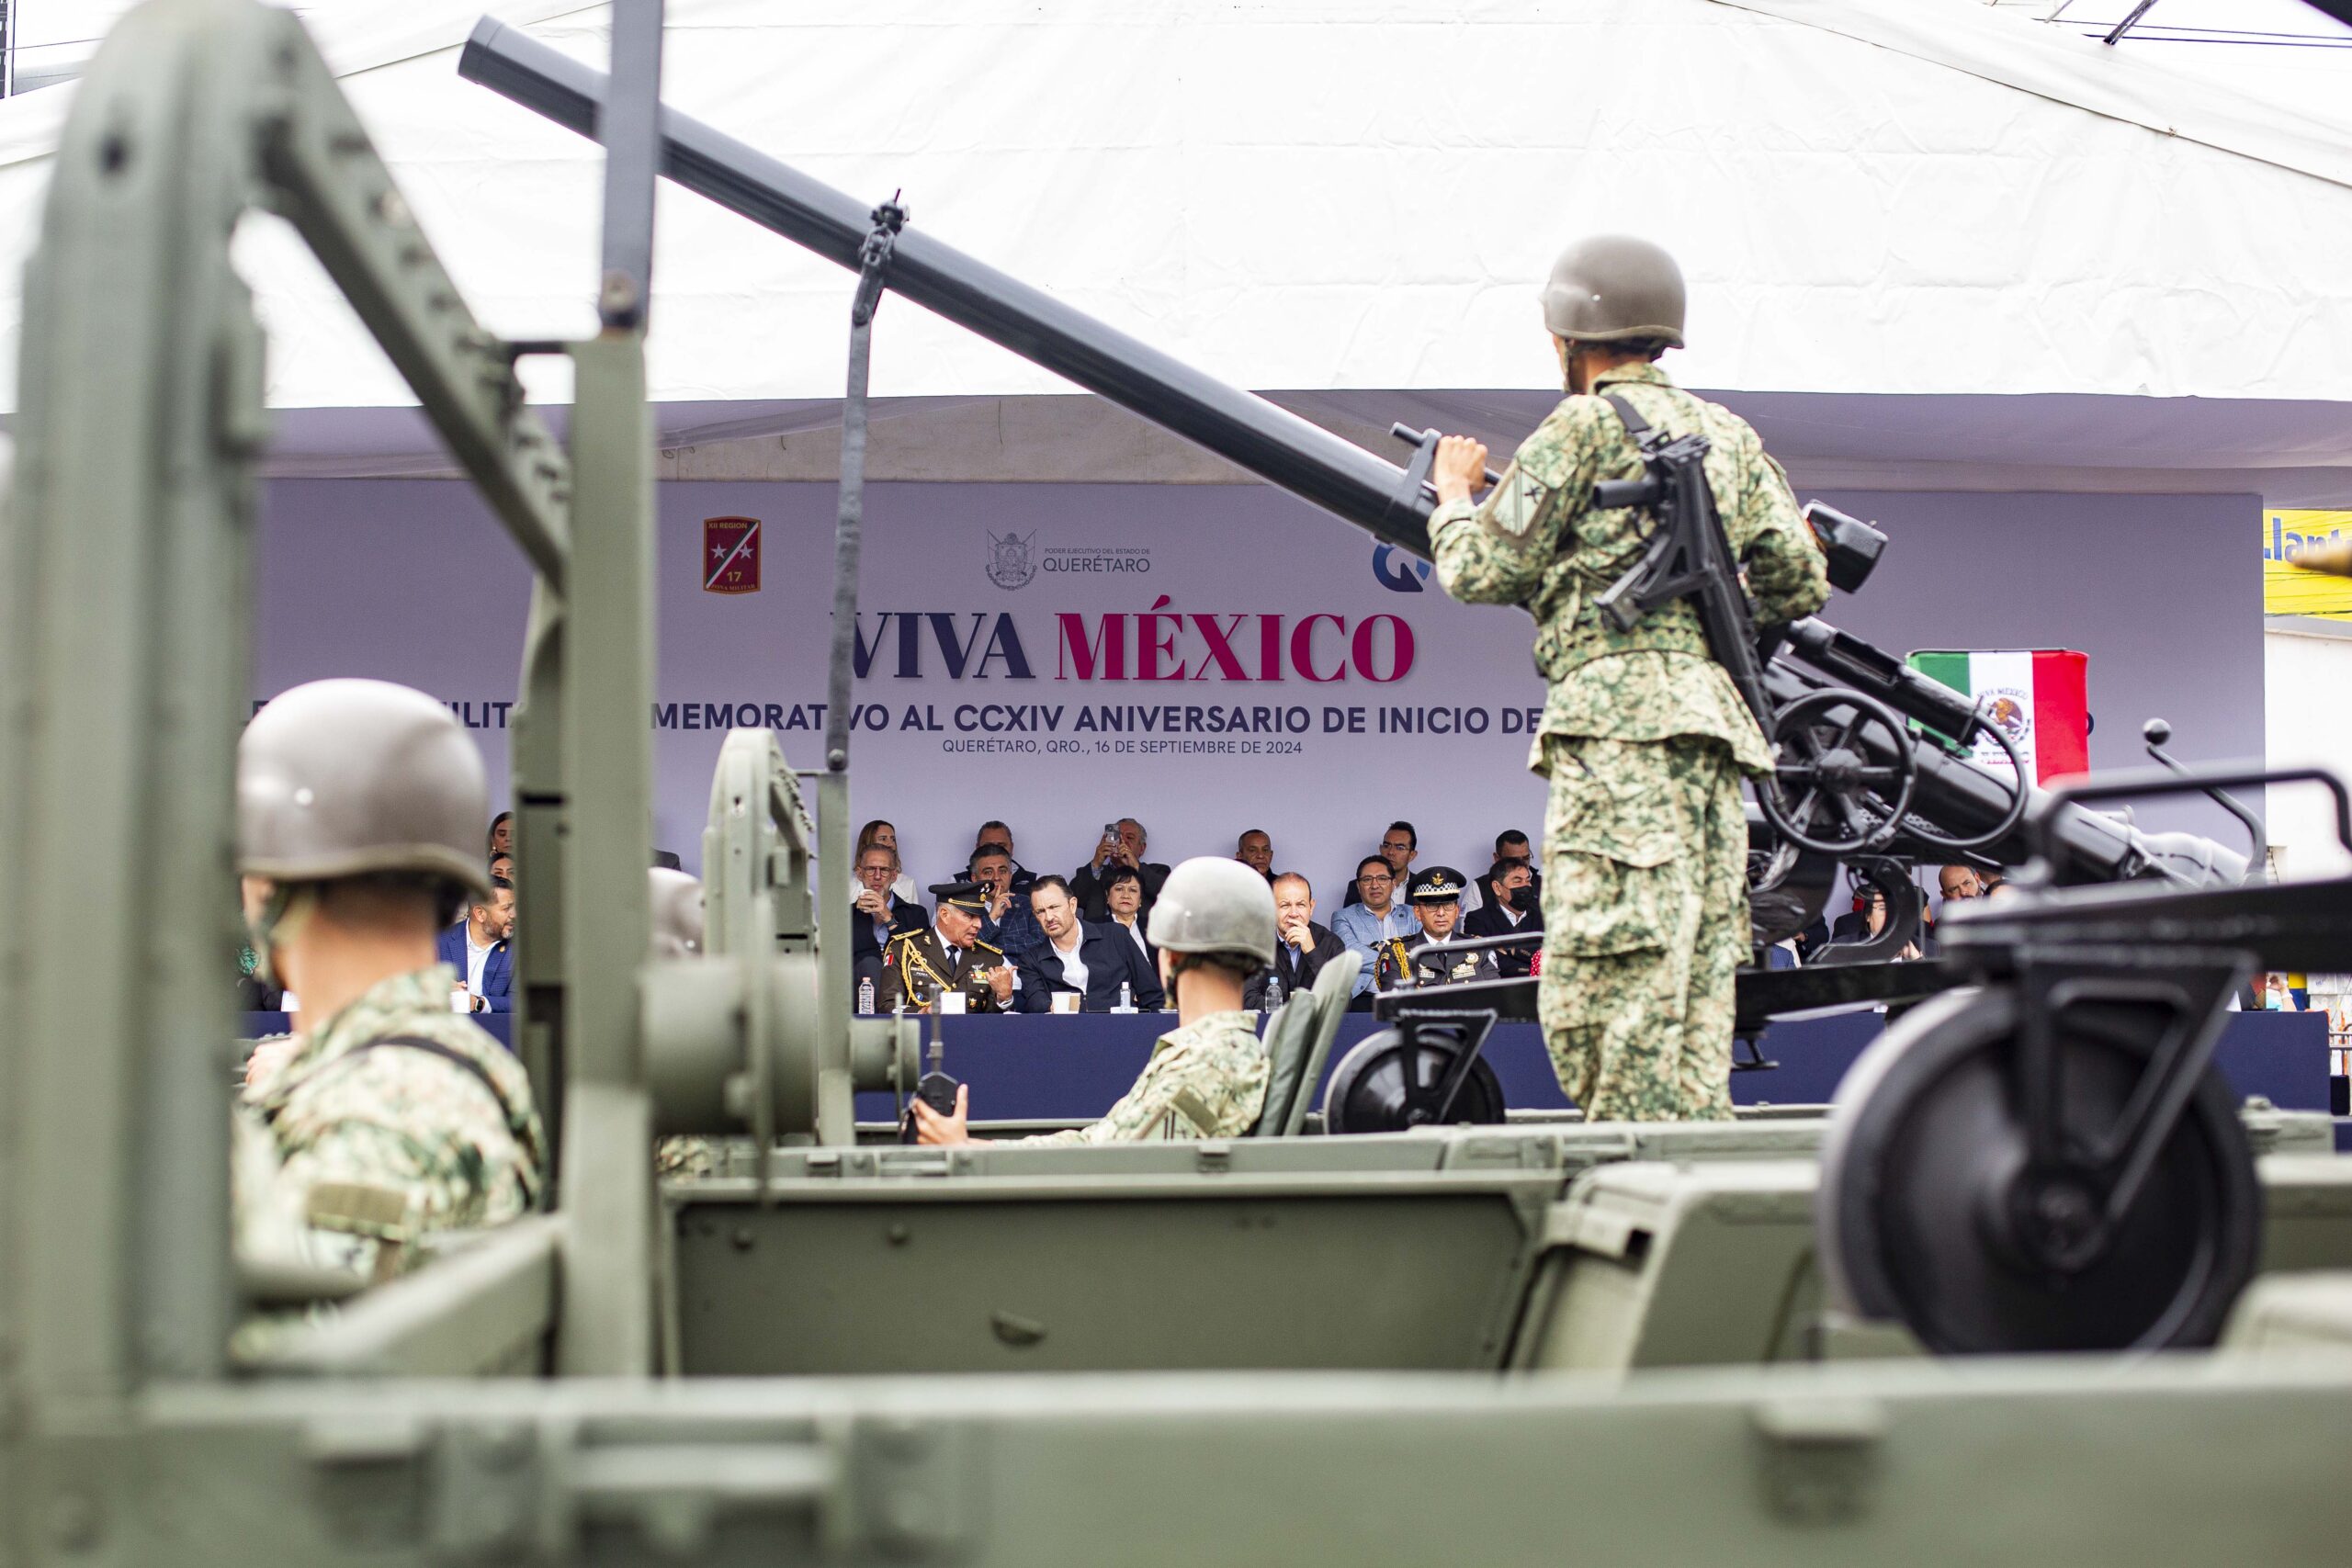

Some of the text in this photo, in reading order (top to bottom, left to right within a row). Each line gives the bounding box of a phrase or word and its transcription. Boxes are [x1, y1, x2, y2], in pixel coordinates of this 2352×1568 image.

[1043, 555, 1150, 572] QUERÉTARO
[727, 571, 741, 582] 17
[830, 594, 1415, 682] VIVA MÉXICO
[900, 705, 944, 731] AL
[954, 705, 1064, 732] CCXIV
[1073, 705, 1310, 734] ANIVERSARIO
[1323, 707, 1366, 733] DE
[1379, 707, 1489, 734] INICIO
[943, 737, 1302, 755] QUERÉTARO, QRO., 16 DE SEPTIEMBRE DE 2024
